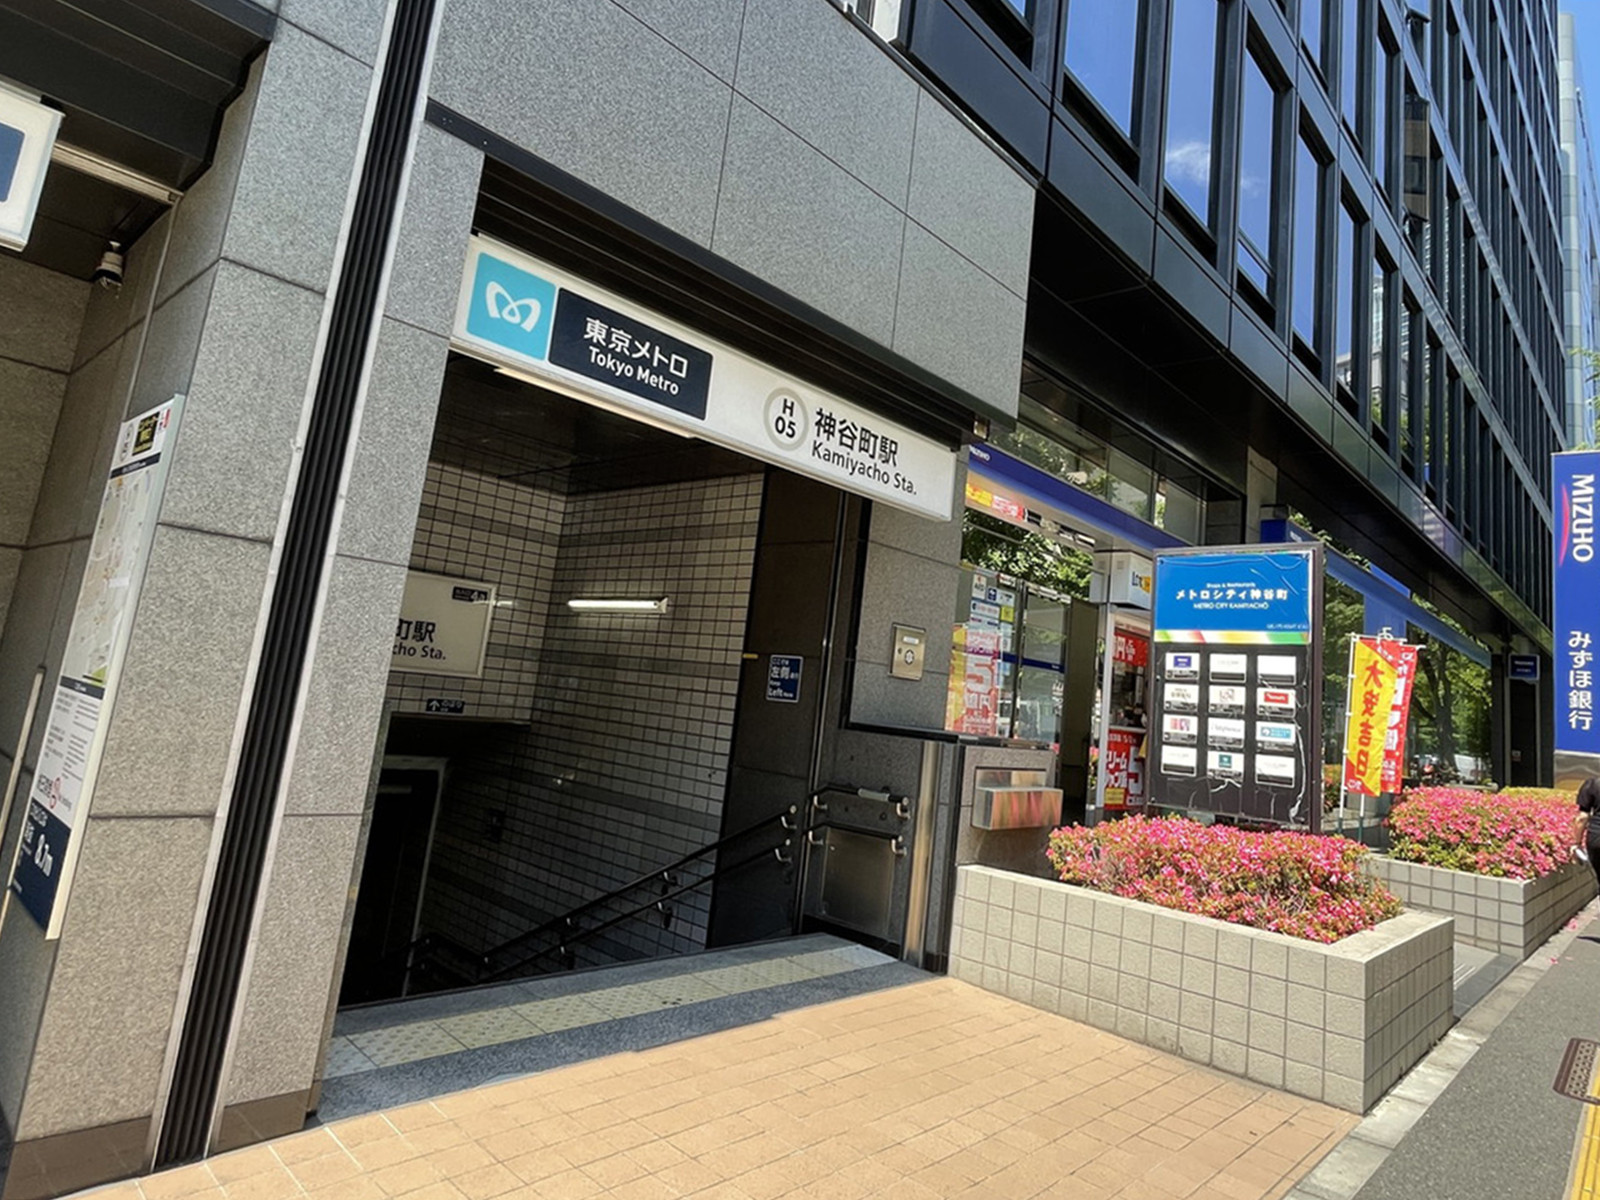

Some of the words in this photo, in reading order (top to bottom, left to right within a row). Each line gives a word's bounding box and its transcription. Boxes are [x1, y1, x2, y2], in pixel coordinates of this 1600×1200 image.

[583, 316, 688, 380] 東京メトロ
[588, 346, 635, 380] Tokyo
[637, 363, 680, 397] Metro
[774, 416, 797, 441] 05
[782, 397, 795, 418] H
[814, 407, 900, 468] 神谷町駅
[811, 441, 891, 487] Kamiyacho
[893, 470, 918, 497] Sta.
[1572, 473, 1595, 563] MIZUHO
[1175, 588, 1288, 601] メトロシティ神谷町
[421, 645, 447, 660] Sta.
[1568, 630, 1593, 731] みずほ銀行
